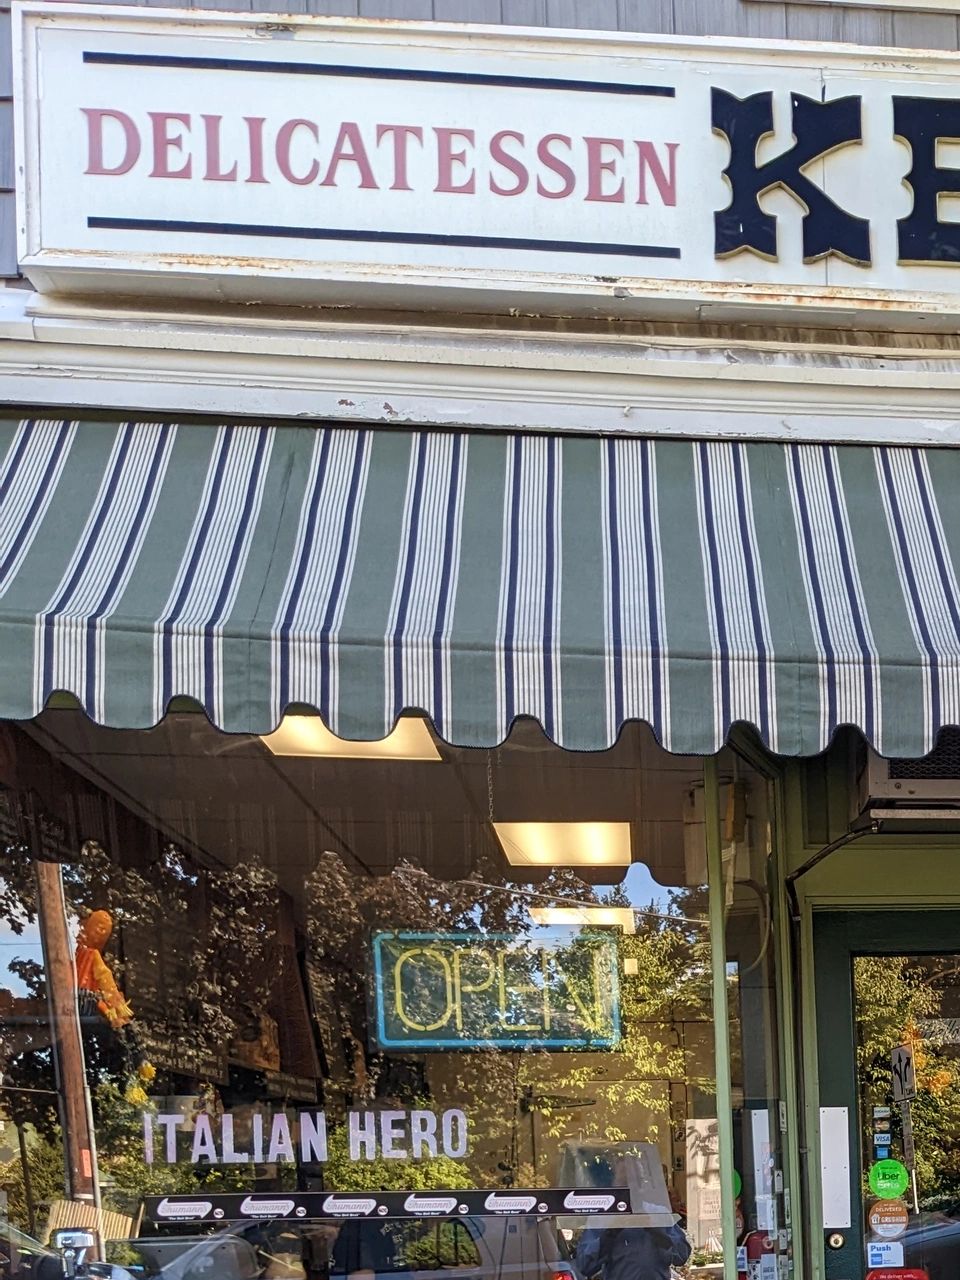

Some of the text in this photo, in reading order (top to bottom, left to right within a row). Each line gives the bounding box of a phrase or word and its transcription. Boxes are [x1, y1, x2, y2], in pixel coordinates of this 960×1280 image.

[80, 107, 681, 207] DELICATESSEN
[394, 948, 604, 1032] OPEN
[143, 1108, 469, 1164] ITALIAN HERO
[877, 1171, 900, 1181] Uber
